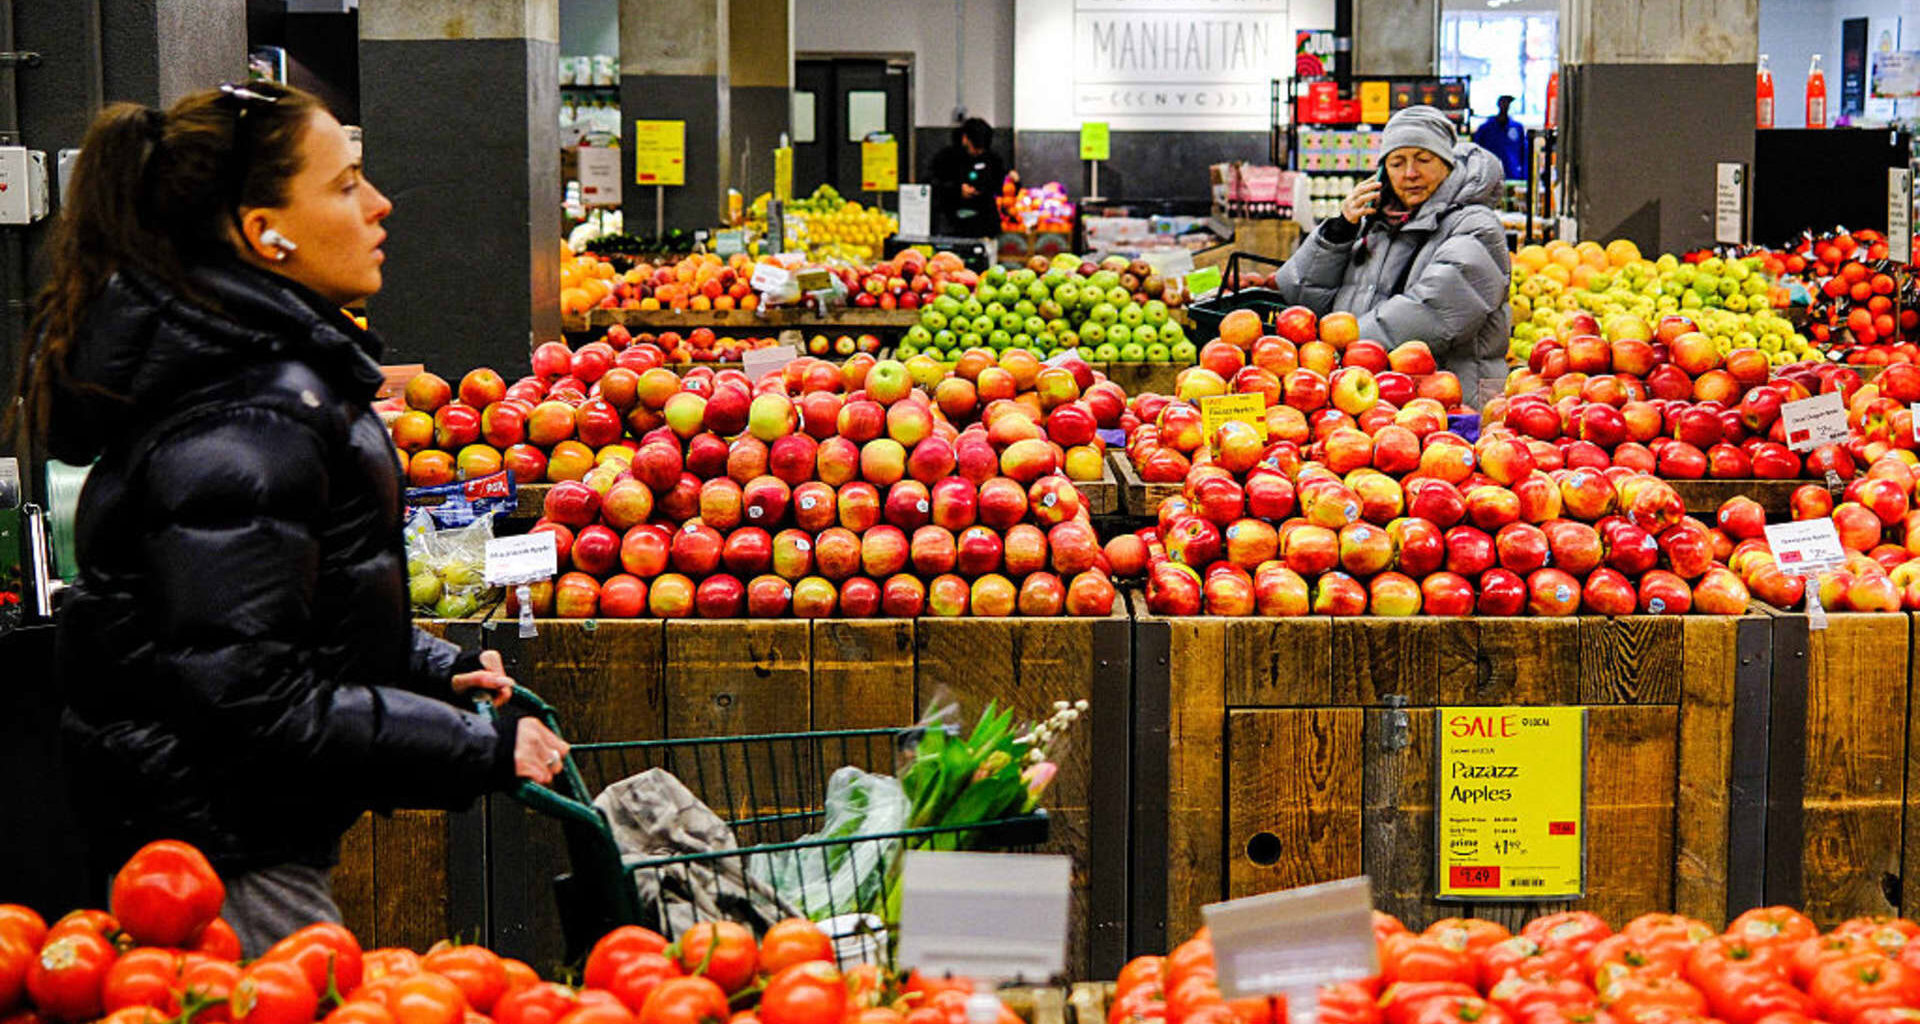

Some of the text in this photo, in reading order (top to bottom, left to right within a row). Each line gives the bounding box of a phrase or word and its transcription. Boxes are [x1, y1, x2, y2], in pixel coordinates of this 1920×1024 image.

[1092, 20, 1270, 70] MANHATTAN
[1449, 714, 1518, 738] SALE
[1452, 761, 1519, 779] Pazazz
[1450, 785, 1512, 804] Apples
[1450, 838, 1479, 849] prime
